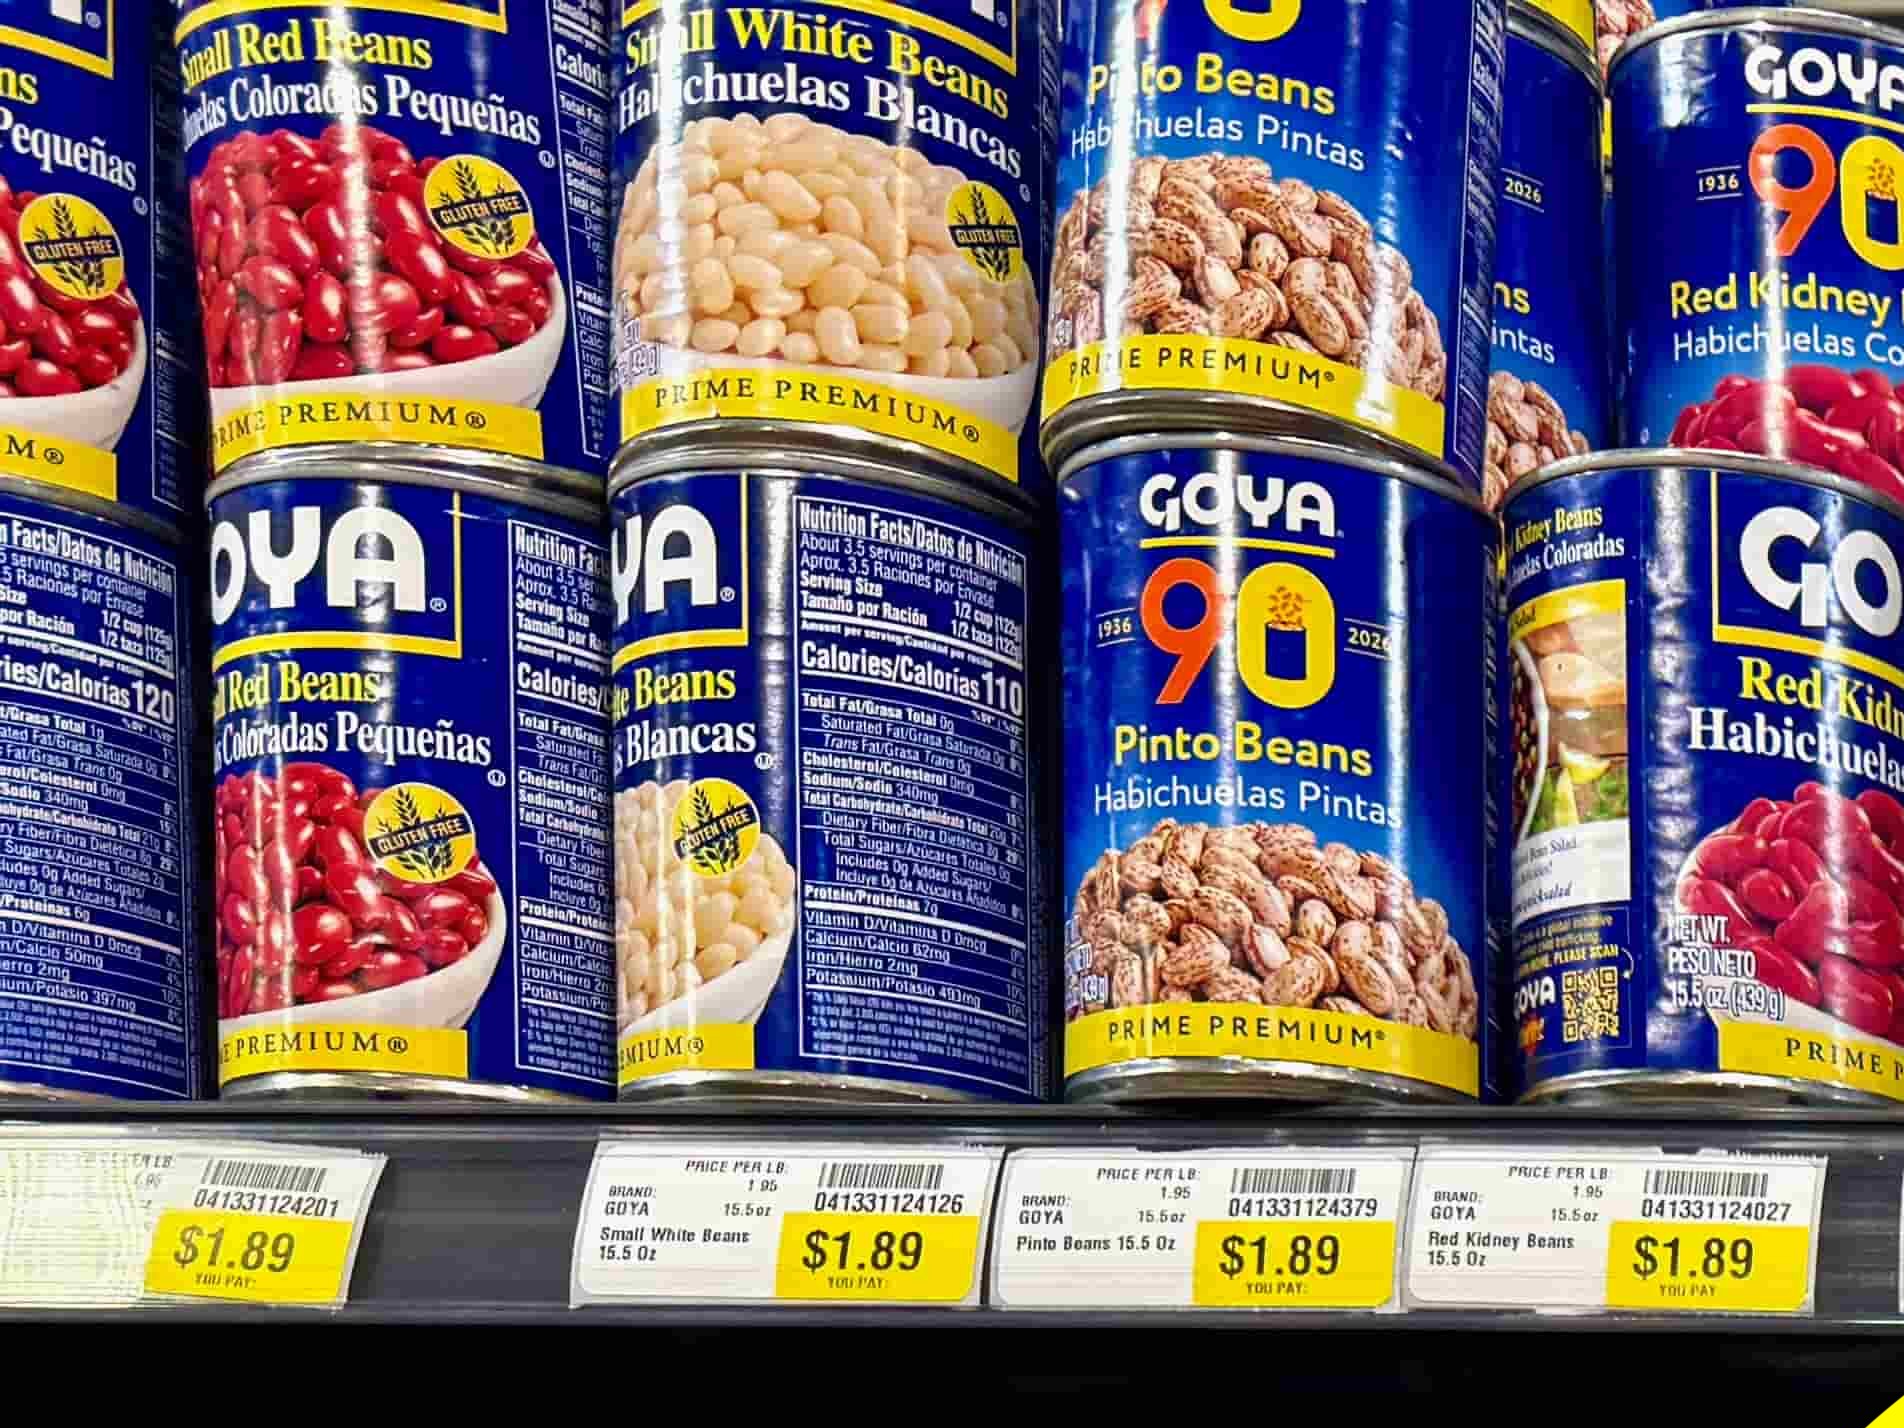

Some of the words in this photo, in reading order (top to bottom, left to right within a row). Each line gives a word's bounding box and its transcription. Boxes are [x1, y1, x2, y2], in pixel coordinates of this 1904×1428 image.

[800, 502, 865, 537] Nutrition
[957, 535, 973, 563] de
[800, 533, 840, 553] About
[844, 538, 865, 556] 3.5
[869, 543, 923, 569] servings
[927, 556, 945, 574] per
[800, 570, 851, 596] Serving
[855, 577, 883, 597] Size
[1113, 721, 1219, 766] Pinto
[1231, 721, 1374, 778] Beans
[1092, 780, 1288, 820] Habichuelas
[1508, 1165, 1551, 1180] PRICE
[1556, 1167, 1585, 1181] PER
[192, 1188, 341, 1219] 041331124201
[814, 1192, 964, 1214] 041331124126
[1228, 1198, 1378, 1218] 041331124379
[1430, 1205, 1476, 1221] GOYA
[1641, 1198, 1793, 1222] 041331124027
[600, 1227, 644, 1242] Small
[651, 1227, 695, 1243] White
[702, 1229, 750, 1244] Beans
[1016, 1236, 1057, 1251] Pinto
[1063, 1236, 1111, 1251] Beans
[1117, 1236, 1150, 1251] 15.5
[1428, 1231, 1459, 1247] Red
[1465, 1233, 1520, 1251] Kidney
[1527, 1234, 1575, 1250] Beans
[173, 1224, 296, 1278] $1.89
[802, 1229, 924, 1273] $1.89
[1219, 1234, 1341, 1280] $1.89
[1632, 1235, 1754, 1281] $1.89
